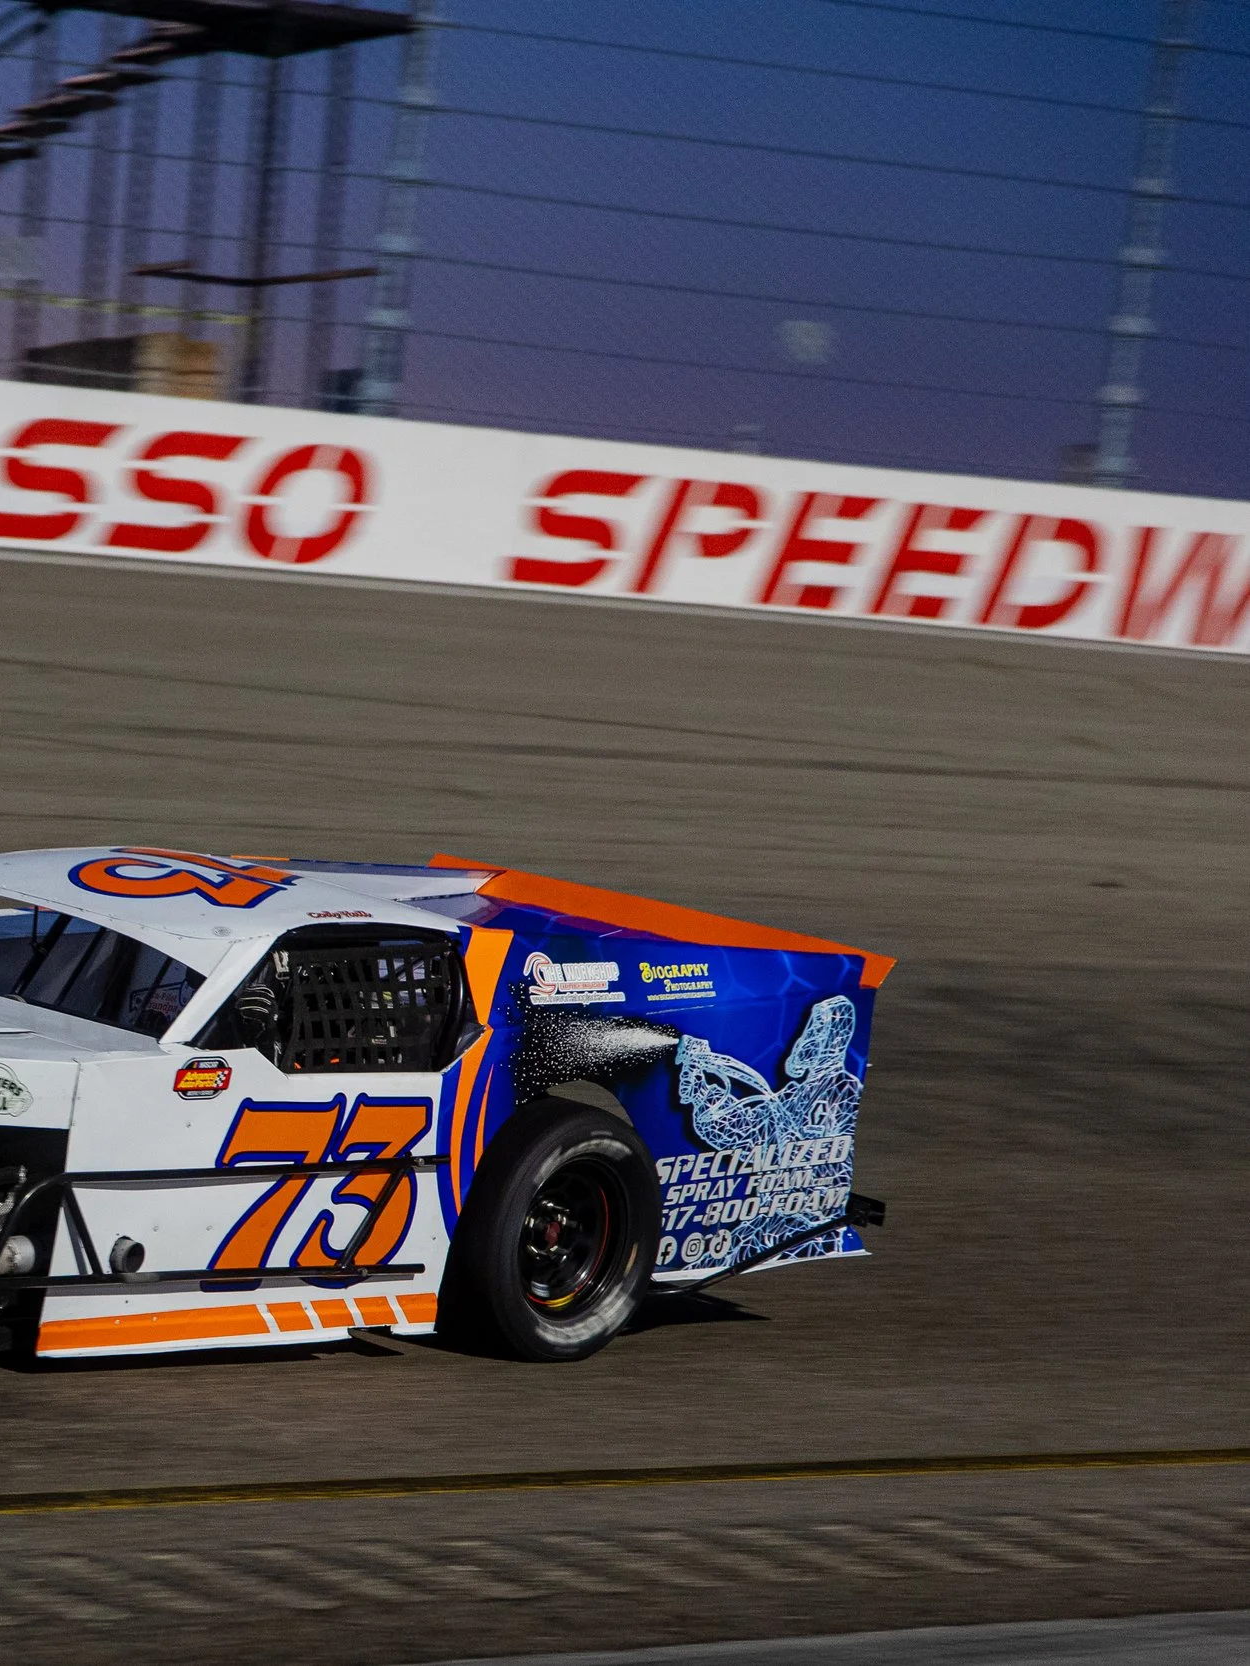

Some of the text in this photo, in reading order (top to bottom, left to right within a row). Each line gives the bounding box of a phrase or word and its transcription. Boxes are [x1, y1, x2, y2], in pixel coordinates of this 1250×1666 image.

[502, 469, 1250, 646] SPEEDW
[542, 962, 619, 982] THE WORKSHOP
[639, 962, 709, 983] BIOGRAPHY
[664, 979, 714, 993] PHOTOGRAPHY
[656, 1135, 852, 1185] SPECIALIZED
[200, 1092, 433, 1293] 73
[664, 1176, 742, 1206] SPRAY
